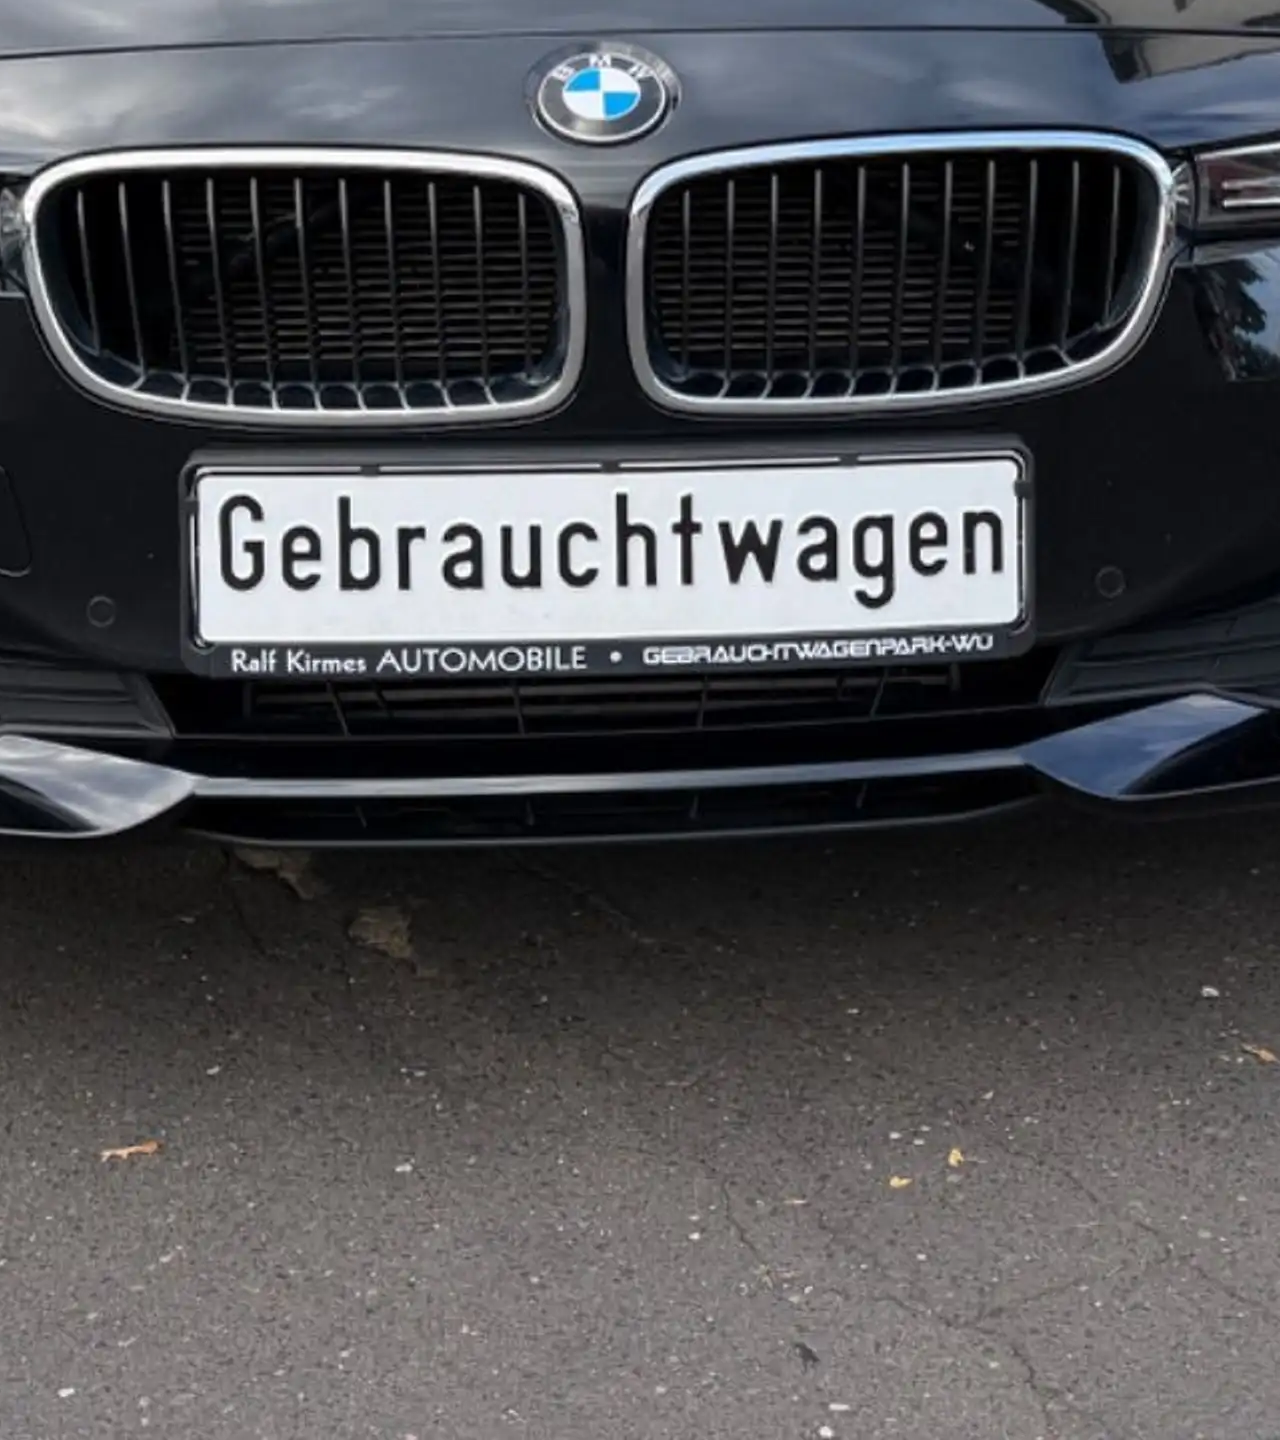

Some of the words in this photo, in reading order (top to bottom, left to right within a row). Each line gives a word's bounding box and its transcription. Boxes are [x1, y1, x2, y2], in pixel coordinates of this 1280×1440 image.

[218, 491, 1004, 610] Gebrauchtwagen
[231, 648, 277, 673] Ralf
[287, 648, 367, 674] Kirmes
[376, 646, 587, 673] AUTOMOBILE
